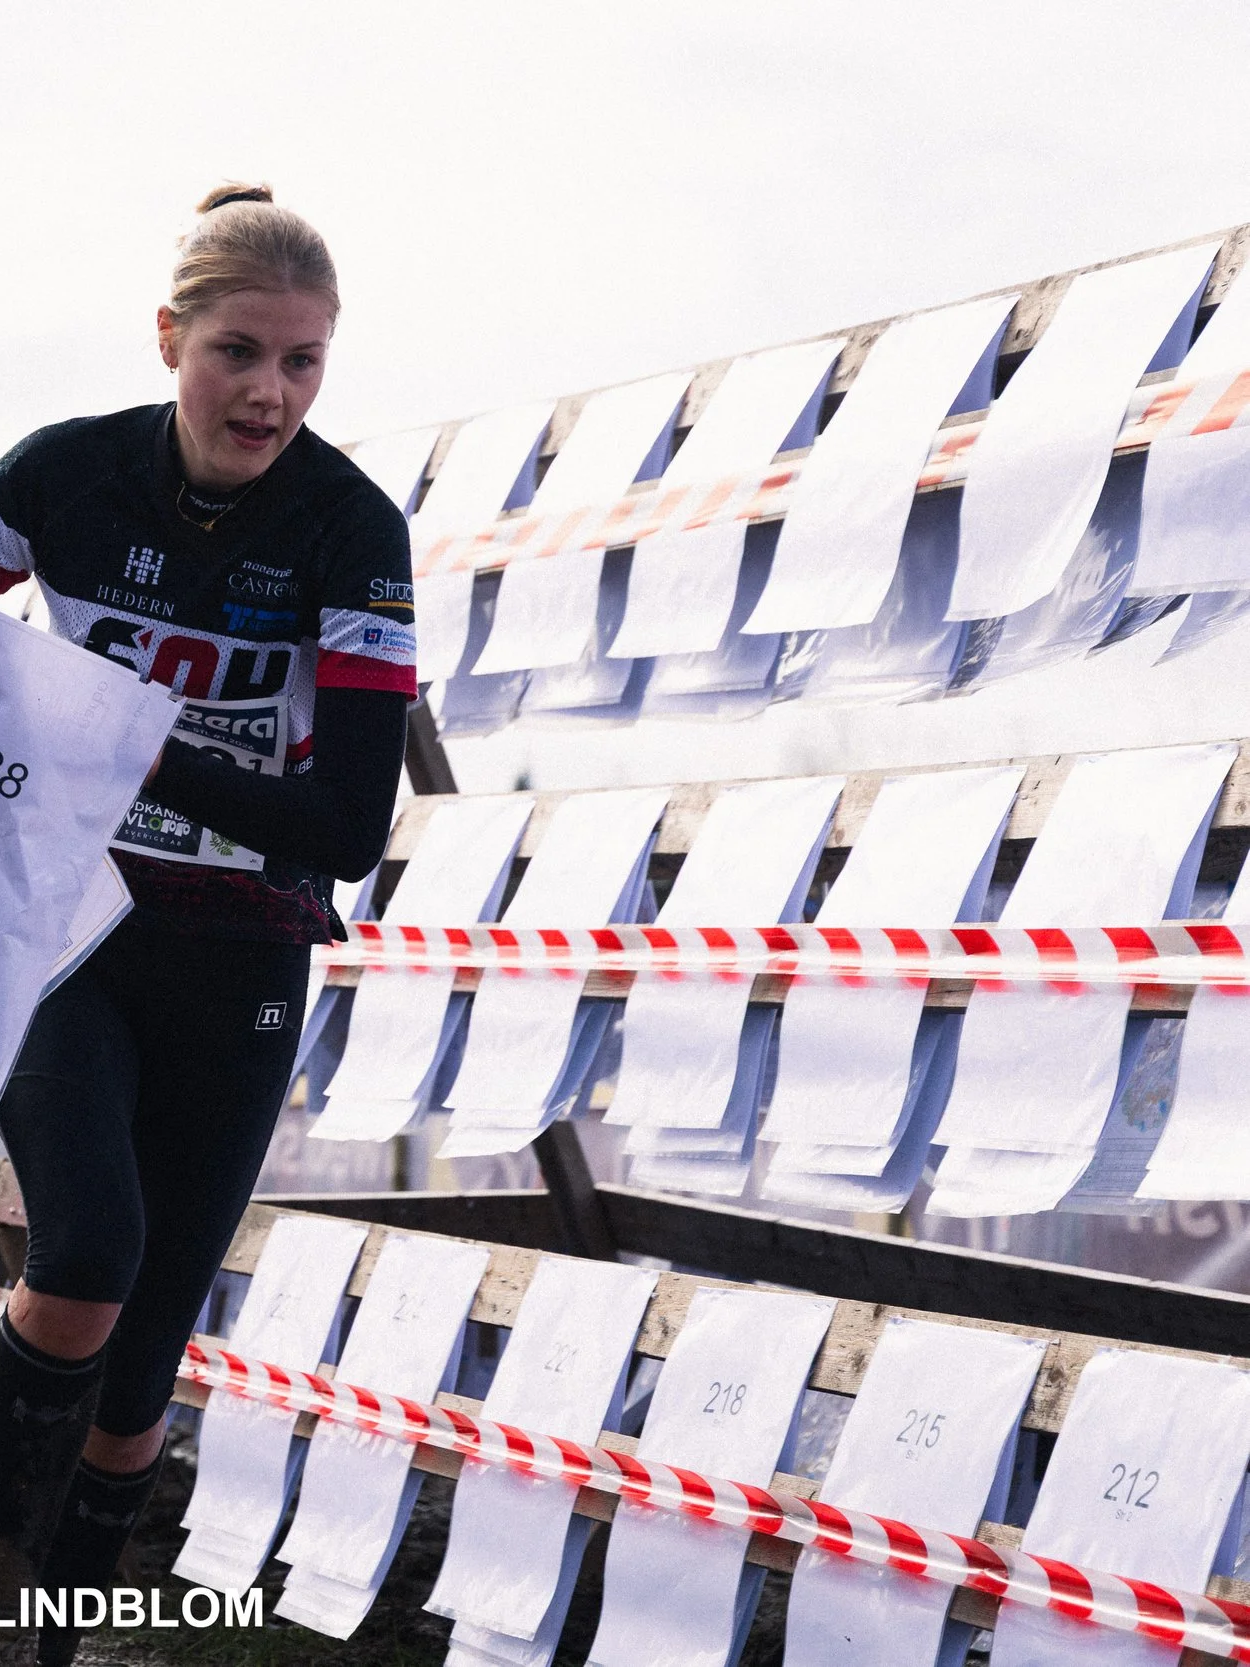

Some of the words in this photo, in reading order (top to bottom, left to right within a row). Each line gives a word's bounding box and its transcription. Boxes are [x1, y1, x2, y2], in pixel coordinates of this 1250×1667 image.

[96, 584, 175, 617] HEDERN
[180, 709, 275, 739] eera
[286, 755, 314, 775] UBB
[124, 829, 165, 844] SVERIGE
[170, 839, 182, 847] AB
[702, 1381, 748, 1416] 218
[895, 1408, 947, 1449] 215
[1102, 1462, 1160, 1509] 212
